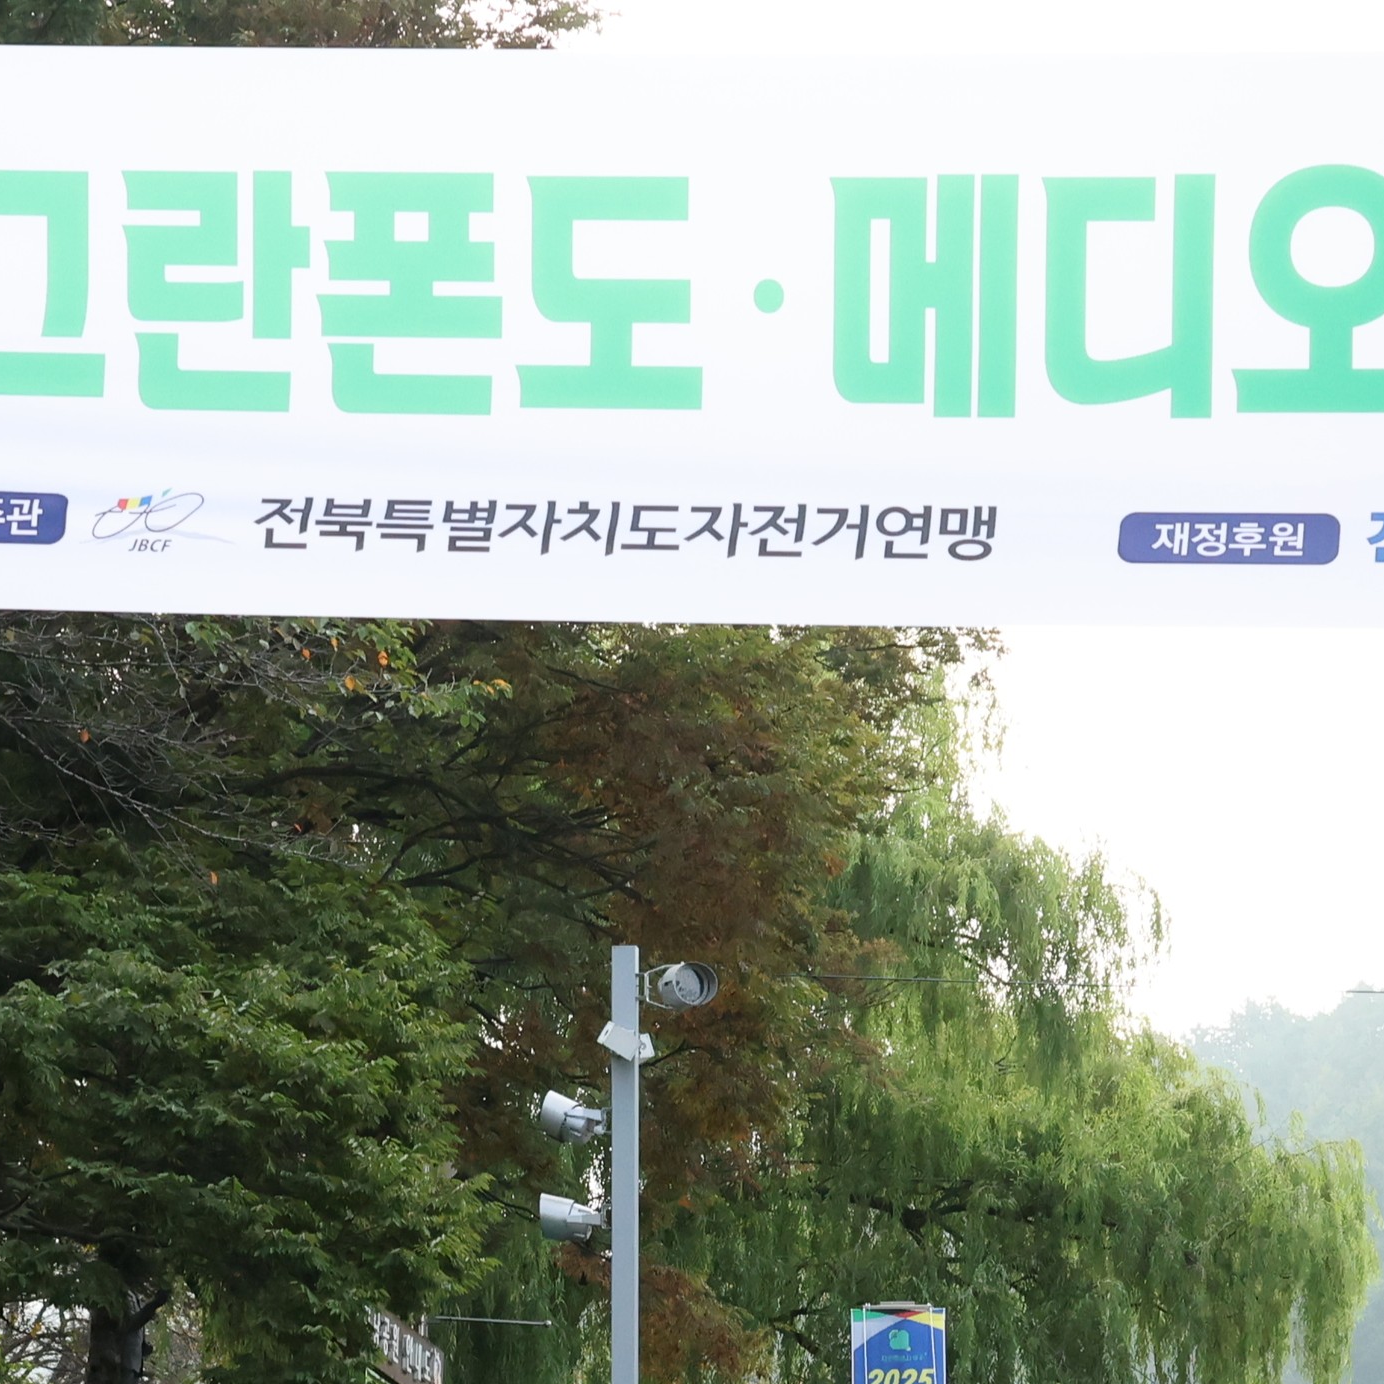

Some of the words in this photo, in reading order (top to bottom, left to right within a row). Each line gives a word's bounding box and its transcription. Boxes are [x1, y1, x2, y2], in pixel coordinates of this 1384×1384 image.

[128, 538, 173, 553] JBCF
[255, 496, 998, 561] 전북특별자치도자전거연맹
[1151, 521, 1306, 557] 재정후원
